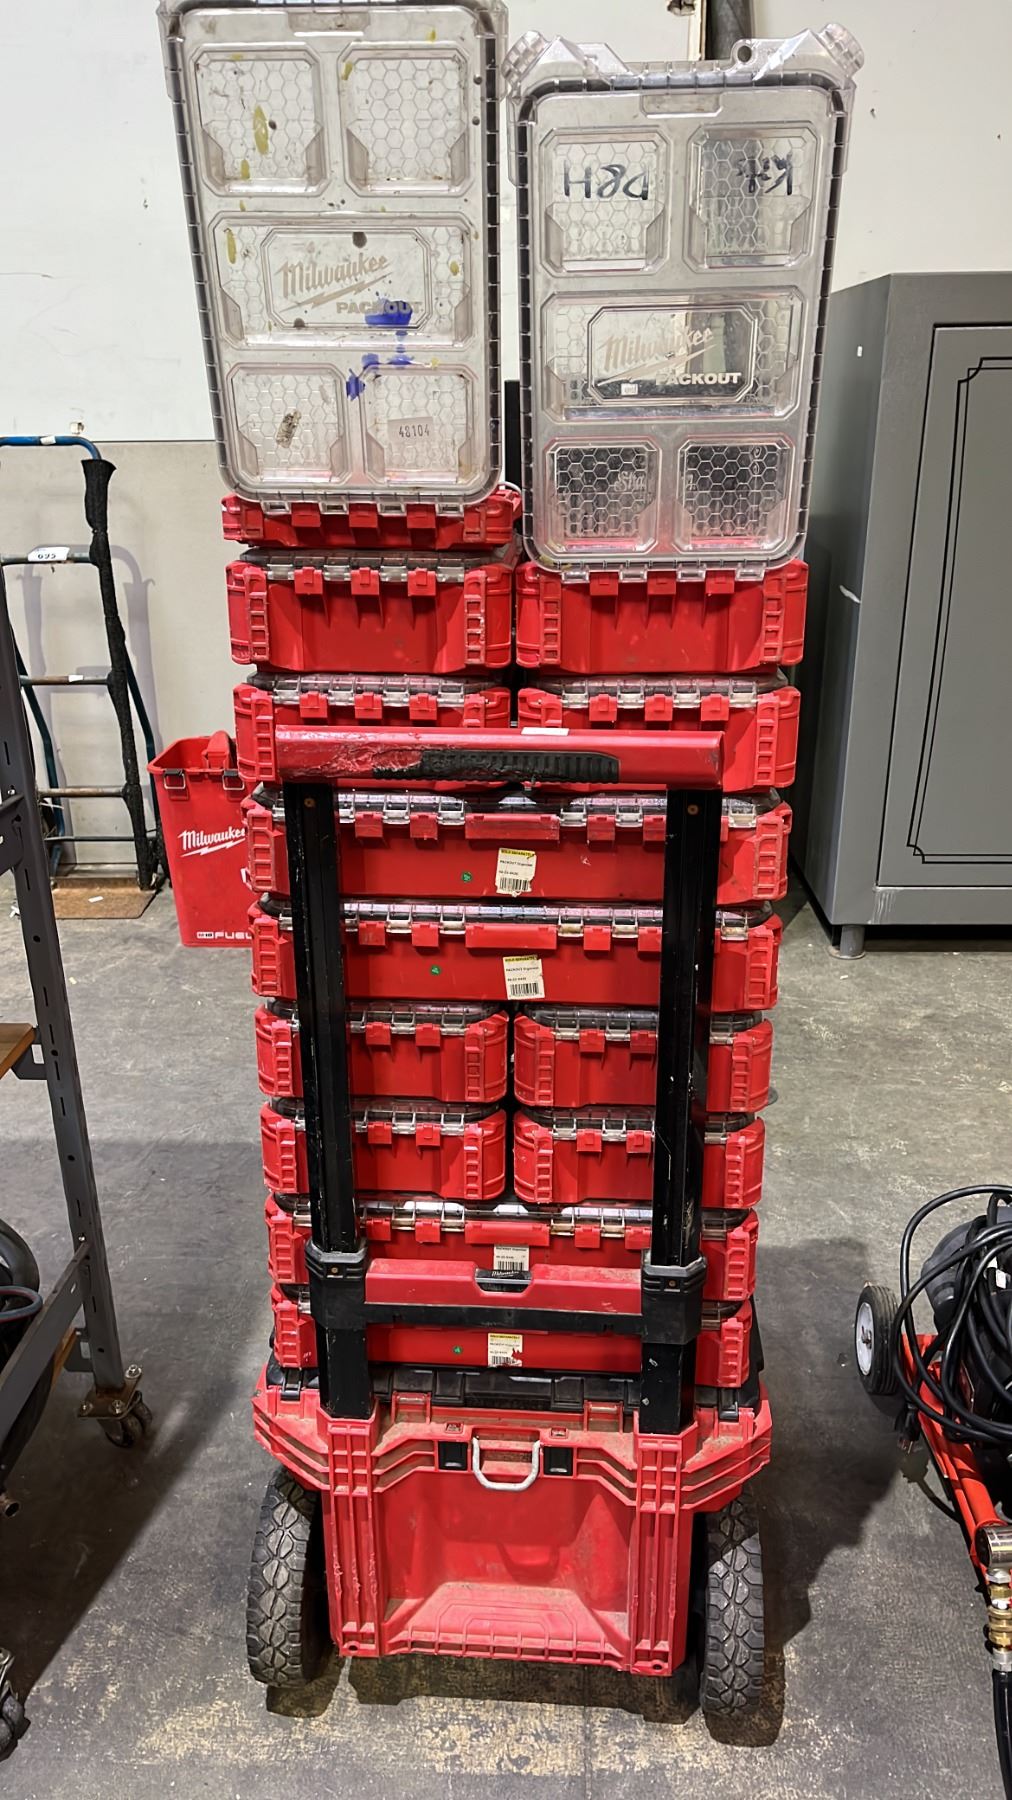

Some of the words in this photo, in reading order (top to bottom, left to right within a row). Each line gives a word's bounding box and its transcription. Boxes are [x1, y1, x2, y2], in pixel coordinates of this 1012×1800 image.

[274, 252, 392, 299] Milwaukee
[597, 326, 714, 371] Milwaukee
[656, 372, 741, 385] PACKOUT
[399, 424, 429, 437] 48104
